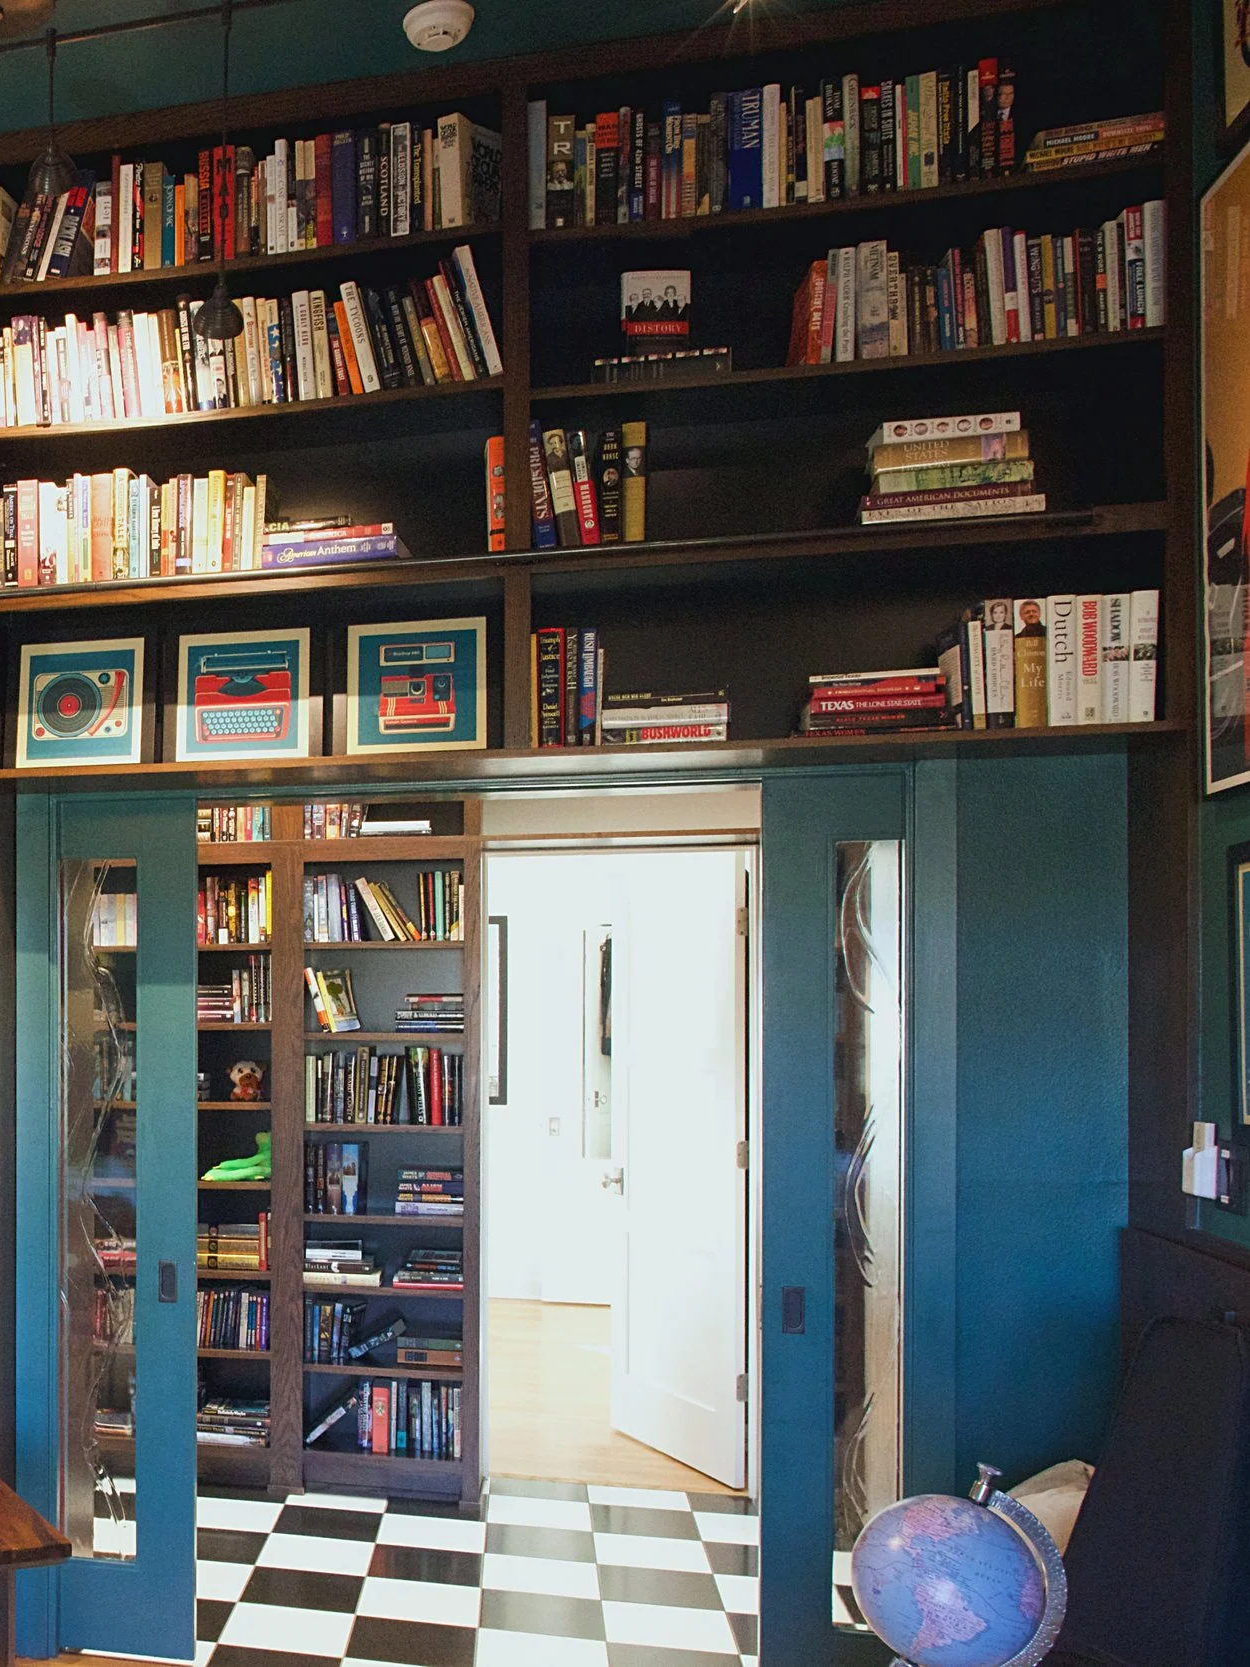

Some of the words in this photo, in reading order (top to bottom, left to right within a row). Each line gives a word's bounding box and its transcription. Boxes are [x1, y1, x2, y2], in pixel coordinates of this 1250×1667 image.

[882, 81, 893, 107] SNAKES
[742, 93, 760, 149] TRUMAN
[882, 109, 893, 117] IN
[882, 119, 893, 139] SUITS
[414, 143, 422, 157] The
[636, 140, 643, 148] OF
[1046, 138, 1072, 147] MICHAEL
[1073, 133, 1095, 142] MOORE
[1061, 153, 1096, 165] STUPID
[1098, 148, 1128, 159] WHITE
[1130, 144, 1152, 152] MEN
[200, 151, 210, 190] RUSSIA
[380, 156, 388, 216] SCOTLAND
[869, 244, 879, 280] VIETNAM
[1135, 262, 1143, 282] FREE
[888, 256, 899, 320] OVERTHROW
[1136, 284, 1145, 314] LUNCH
[312, 296, 324, 331] KINGFISH
[343, 285, 354, 302] THE
[349, 305, 366, 344] TYCOONS
[634, 324, 682, 333] DISTORY
[904, 441, 950, 452] UNITED
[905, 450, 949, 461] STATES
[529, 446, 549, 520] PRESIDENTS
[580, 484, 593, 523] MANHUNT
[877, 496, 905, 505] GREAT
[906, 491, 950, 503] AMERICAN
[953, 488, 1010, 499] DOCUMENTS
[269, 522, 290, 531] CIA
[277, 547, 317, 563] American
[317, 544, 356, 556] Anthem
[1082, 601, 1097, 620] BOB
[1110, 598, 1121, 642] SHADOW
[585, 633, 595, 648] RUSH
[1054, 601, 1074, 663] Dutch
[1082, 621, 1098, 676] WOODWARD
[583, 650, 594, 688] LIMBAUGH
[1024, 663, 1042, 679] My
[1021, 677, 1045, 688] Life
[821, 701, 854, 711] TEXAS
[855, 700, 867, 708] THE
[641, 724, 711, 740] BUSHWORLD
